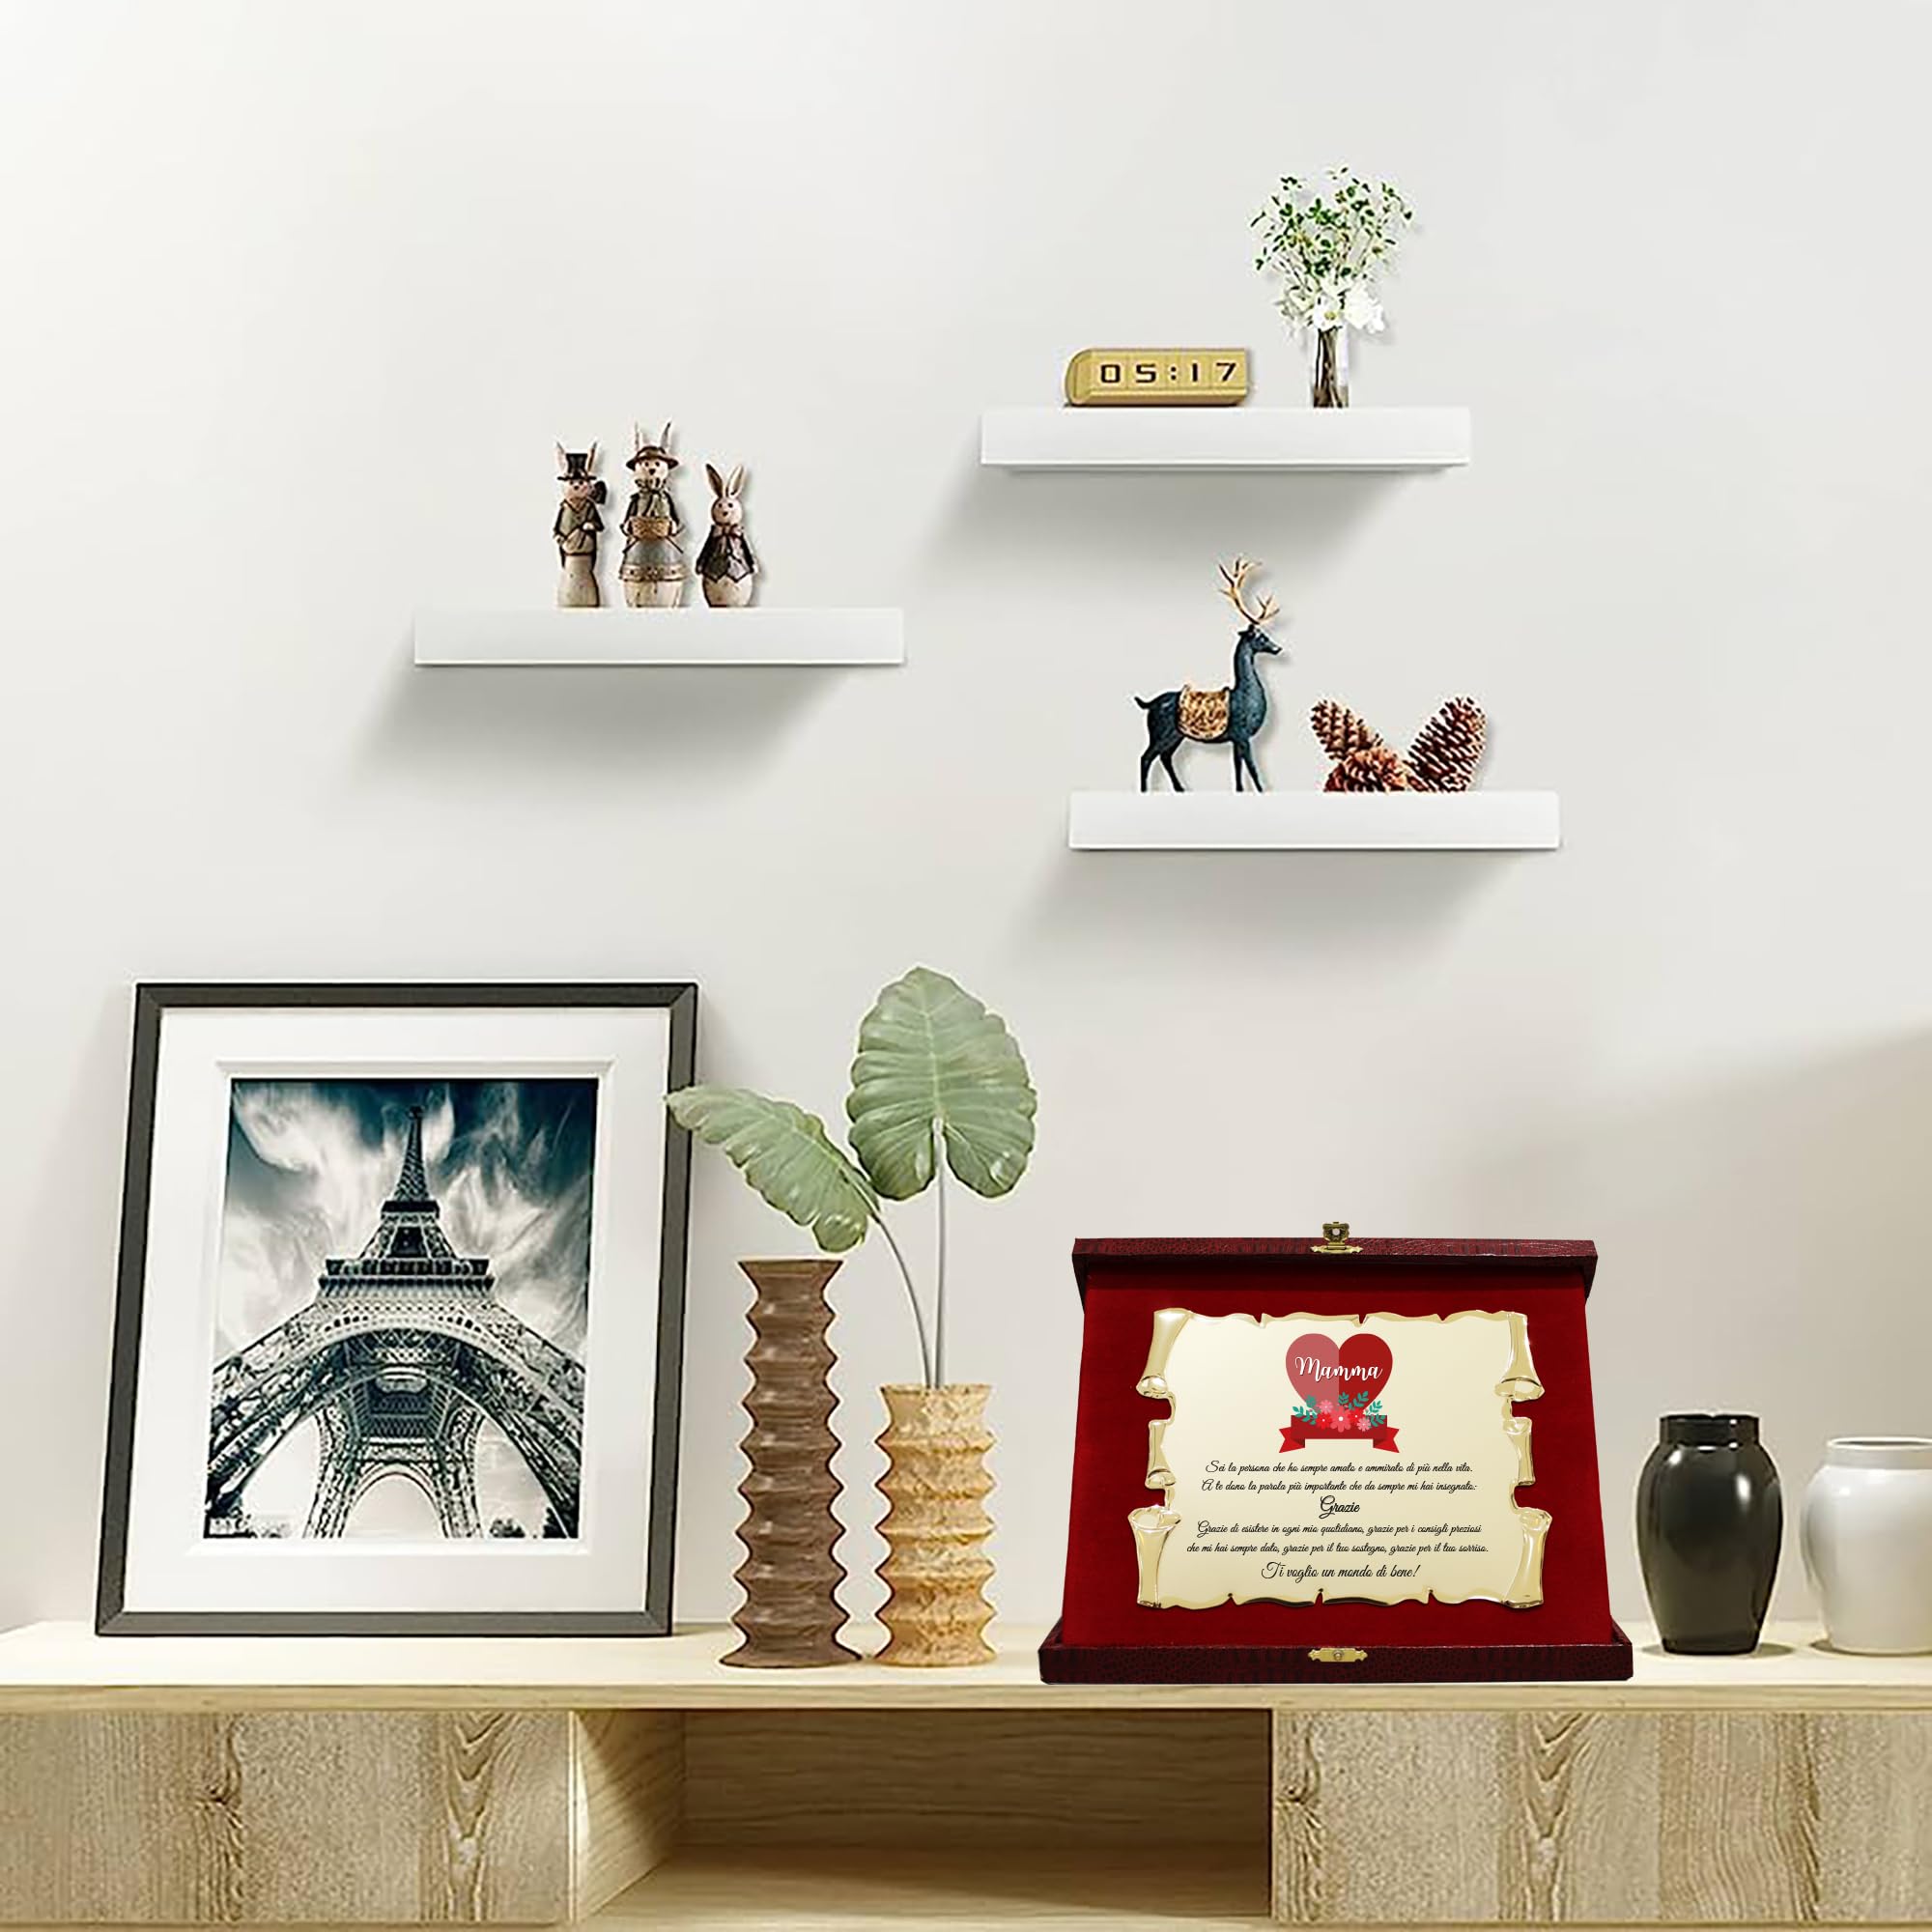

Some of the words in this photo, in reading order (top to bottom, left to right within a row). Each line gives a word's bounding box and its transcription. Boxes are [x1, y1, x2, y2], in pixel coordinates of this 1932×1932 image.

[1100, 362, 1236, 384] 05:17
[1294, 1356, 1383, 1382] Mamma
[1206, 1460, 1226, 1473] Sei
[1228, 1462, 1236, 1472] la
[1237, 1464, 1270, 1475] persona
[1272, 1462, 1287, 1472] che
[1287, 1462, 1299, 1472] ho
[1300, 1464, 1328, 1475] sempre
[1329, 1462, 1356, 1472] amato
[1364, 1462, 1405, 1472] ammirato
[1406, 1462, 1416, 1472] di
[1415, 1463, 1432, 1475] più
[1432, 1462, 1454, 1472] nella
[1455, 1462, 1473, 1472] vita.
[1201, 1478, 1214, 1492] A
[1215, 1480, 1224, 1491] te
[1225, 1480, 1246, 1491] dono
[1247, 1480, 1258, 1491] la
[1257, 1480, 1287, 1494] parola
[1286, 1481, 1303, 1494] più
[1304, 1480, 1348, 1494] importante
[1349, 1480, 1363, 1491] che
[1364, 1480, 1377, 1491] da
[1377, 1483, 1406, 1494] sempre
[1406, 1482, 1419, 1491] mi
[1419, 1480, 1435, 1491] hai
[1318, 1494, 1361, 1520] Grazie
[1196, 1520, 1229, 1539] Grazie
[1230, 1522, 1240, 1533] di
[1240, 1522, 1269, 1533] esistere
[1270, 1524, 1281, 1533] in
[1281, 1524, 1301, 1537] ogni
[1301, 1524, 1320, 1533] mio
[1320, 1522, 1365, 1537] quotidiano,
[1365, 1524, 1395, 1537] grazie
[1393, 1525, 1410, 1537] per
[1410, 1524, 1416, 1533] i
[1417, 1522, 1449, 1537] consigli
[1448, 1524, 1483, 1537] preziosi
[1186, 1542, 1201, 1552] che
[1201, 1544, 1213, 1552] mi
[1213, 1542, 1229, 1552] hai
[1230, 1545, 1259, 1556] sempre
[1260, 1542, 1280, 1554] dato,
[1281, 1544, 1310, 1556] grazie
[1309, 1545, 1324, 1556] per
[1326, 1542, 1335, 1552] il
[1335, 1542, 1350, 1552] tuo
[1350, 1542, 1387, 1556] sostegno,
[1388, 1544, 1417, 1556] grazie
[1415, 1545, 1433, 1556] per
[1434, 1542, 1442, 1552] il
[1442, 1542, 1458, 1552] tuo
[1458, 1544, 1489, 1552] sorriso.
[1261, 1561, 1286, 1579] Ti
[1286, 1564, 1320, 1584] voglio
[1321, 1569, 1336, 1577] un
[1337, 1564, 1374, 1577] mondo
[1376, 1564, 1388, 1577] di
[1389, 1564, 1422, 1577] bene!
